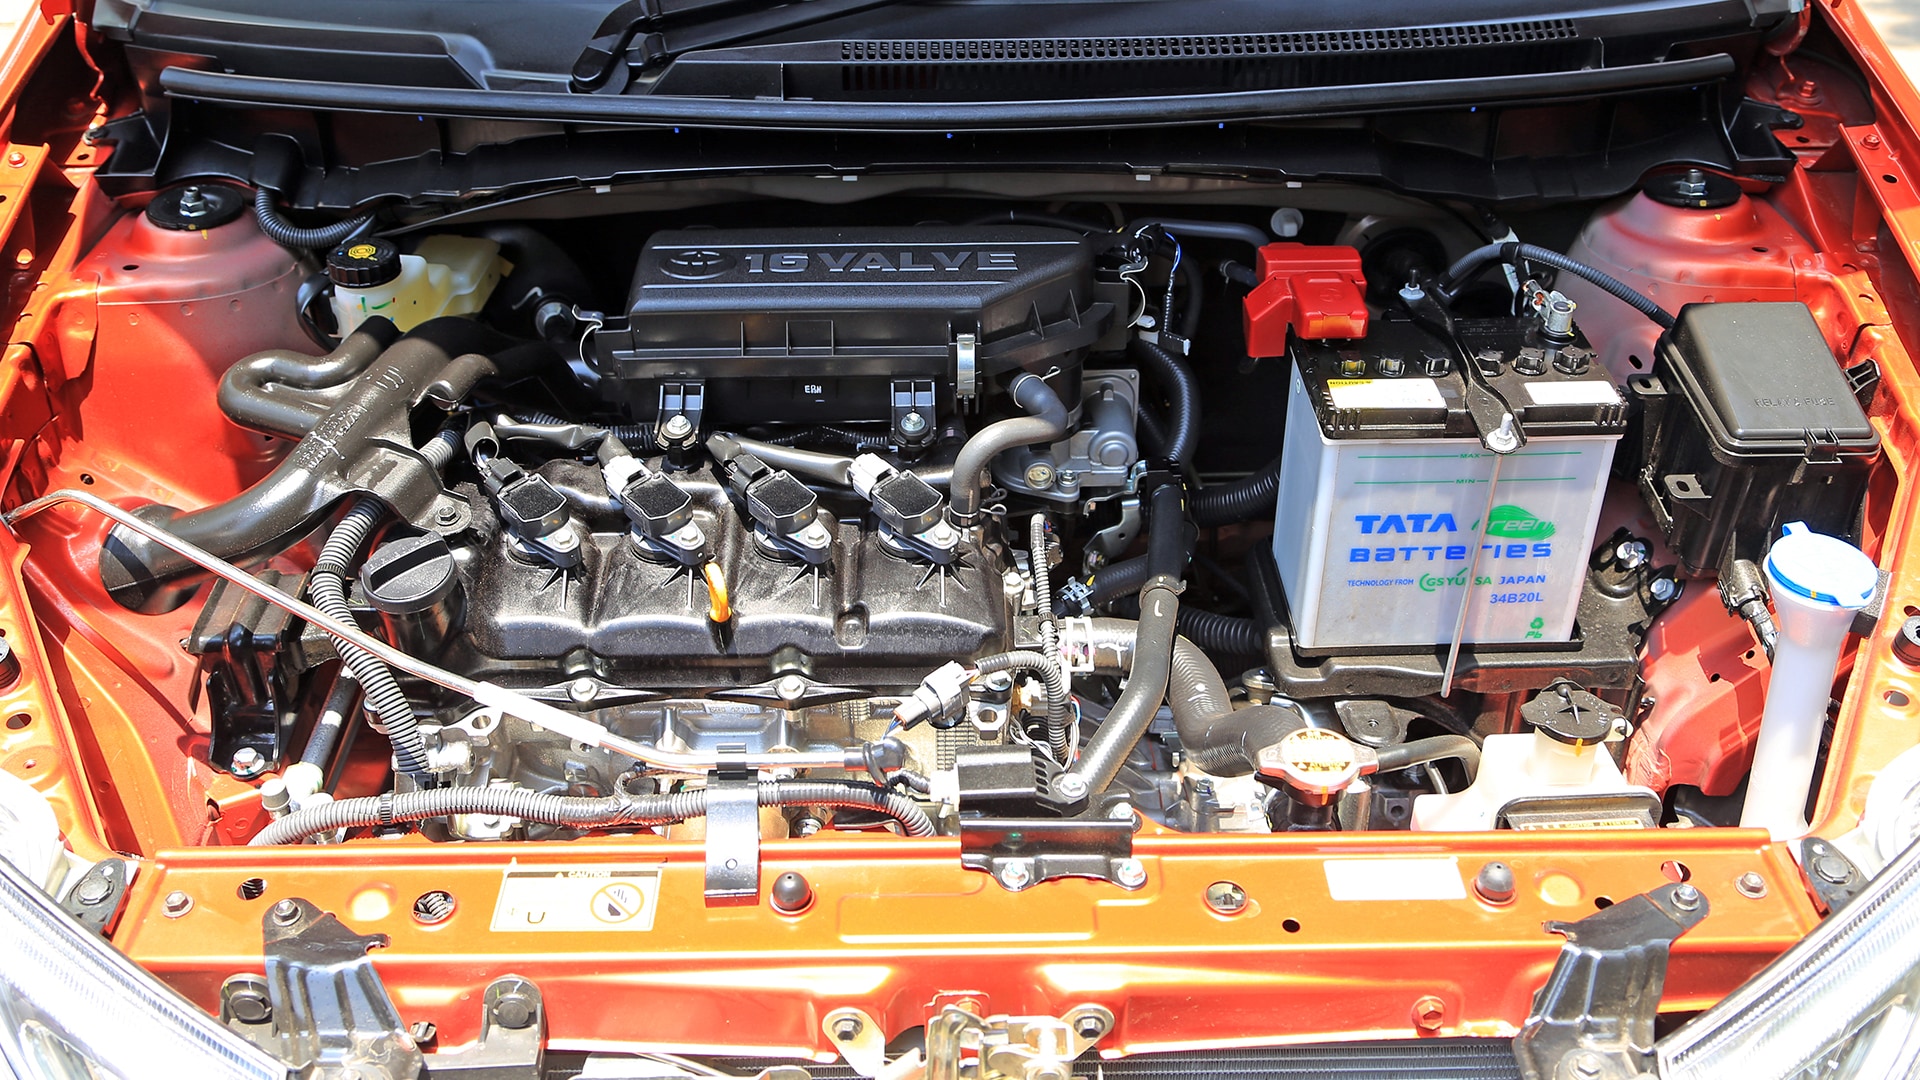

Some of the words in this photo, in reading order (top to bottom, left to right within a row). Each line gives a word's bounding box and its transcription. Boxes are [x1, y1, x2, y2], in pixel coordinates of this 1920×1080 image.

[745, 252, 810, 273] 16
[817, 251, 1019, 273] VALVE
[1754, 397, 1791, 407] RELAY
[1803, 397, 1835, 406] FUSE
[1355, 513, 1458, 534] TATA
[1347, 578, 1394, 587] TECHNOLOGY
[1395, 578, 1414, 586] FROM
[1498, 575, 1546, 585] JAPAN
[1490, 592, 1544, 604] 34B20L
[1524, 630, 1543, 639] Pb
[568, 871, 612, 879] CAUTION
